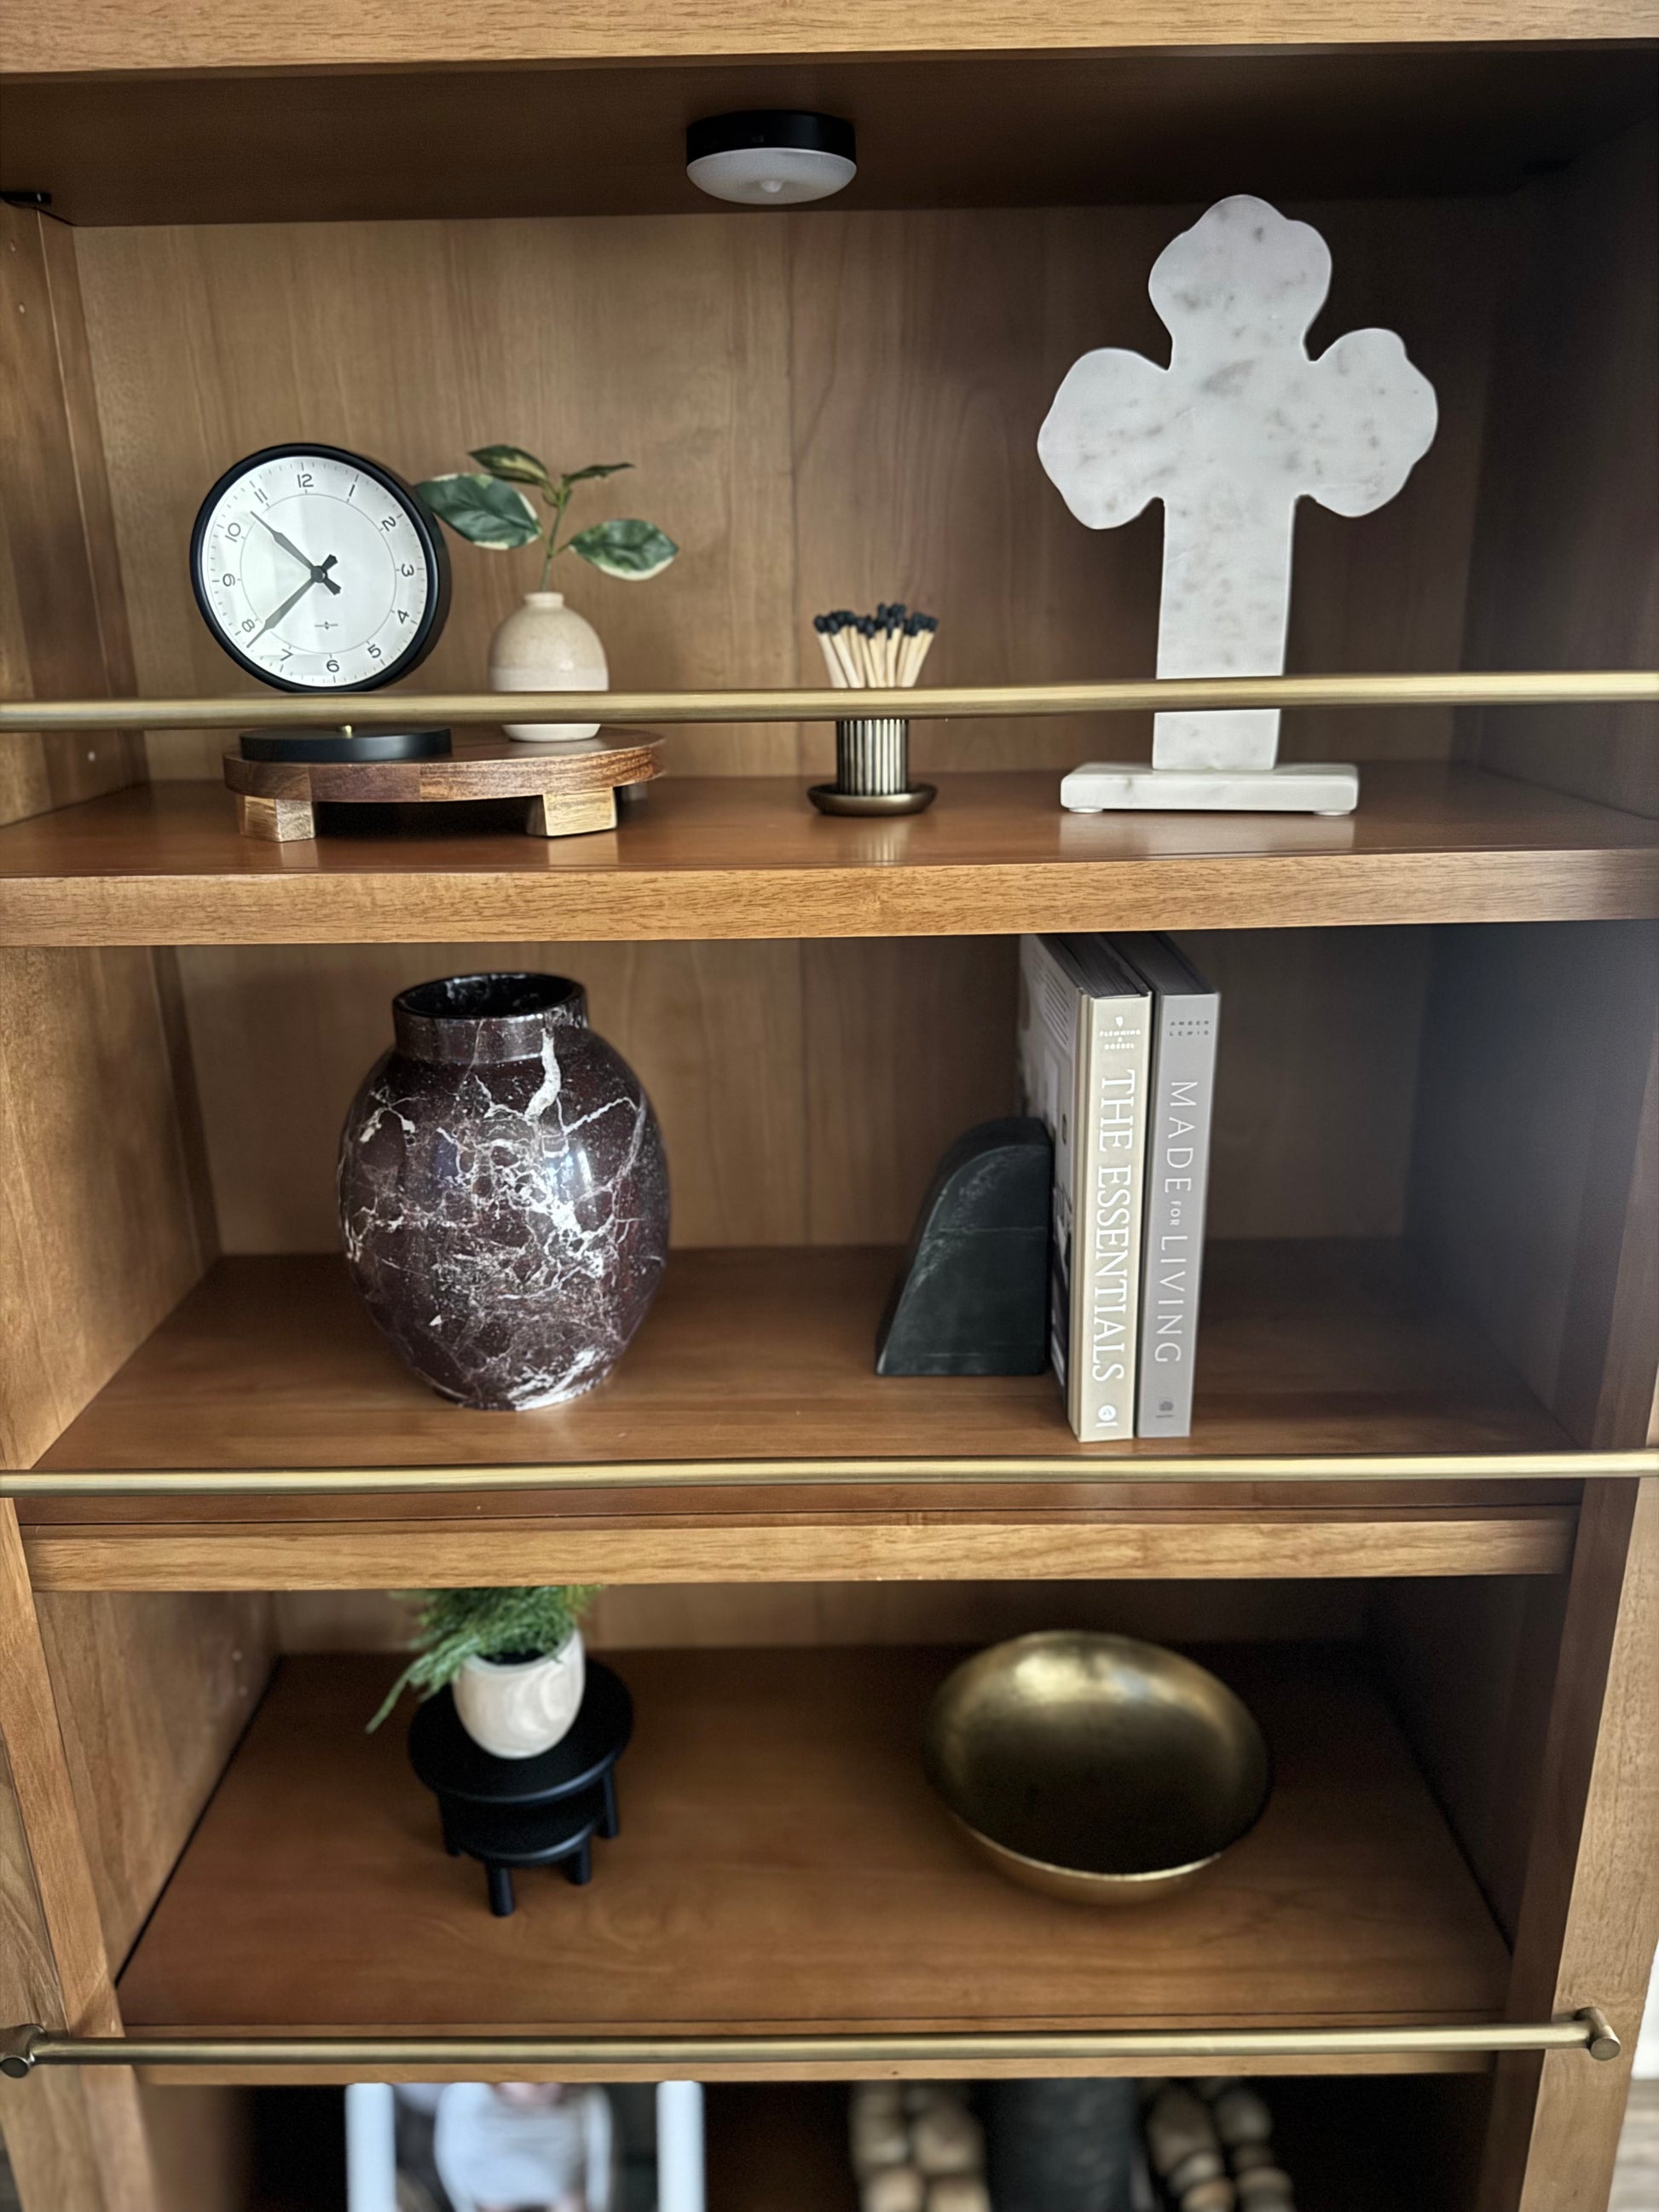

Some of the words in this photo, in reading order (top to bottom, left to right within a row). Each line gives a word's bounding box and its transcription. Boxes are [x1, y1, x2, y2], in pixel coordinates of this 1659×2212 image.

[297, 474, 314, 488] 12
[253, 488, 269, 504] 11
[348, 483, 356, 497] 1
[381, 516, 396, 532] 2
[224, 522, 242, 543] 10
[401, 563, 415, 577] 3
[222, 573, 236, 587] 9
[396, 609, 410, 625] 4
[241, 619, 256, 633] 8
[280, 648, 294, 662] 7
[367, 644, 382, 659] 5
[326, 660, 340, 673] 6
[1099, 1070, 1136, 1152] THE
[1165, 1081, 1199, 1193] MADE
[1169, 1200, 1182, 1226] FOR
[1092, 1164, 1132, 1382] ESSENTIALS
[1154, 1235, 1188, 1363] LIVING
